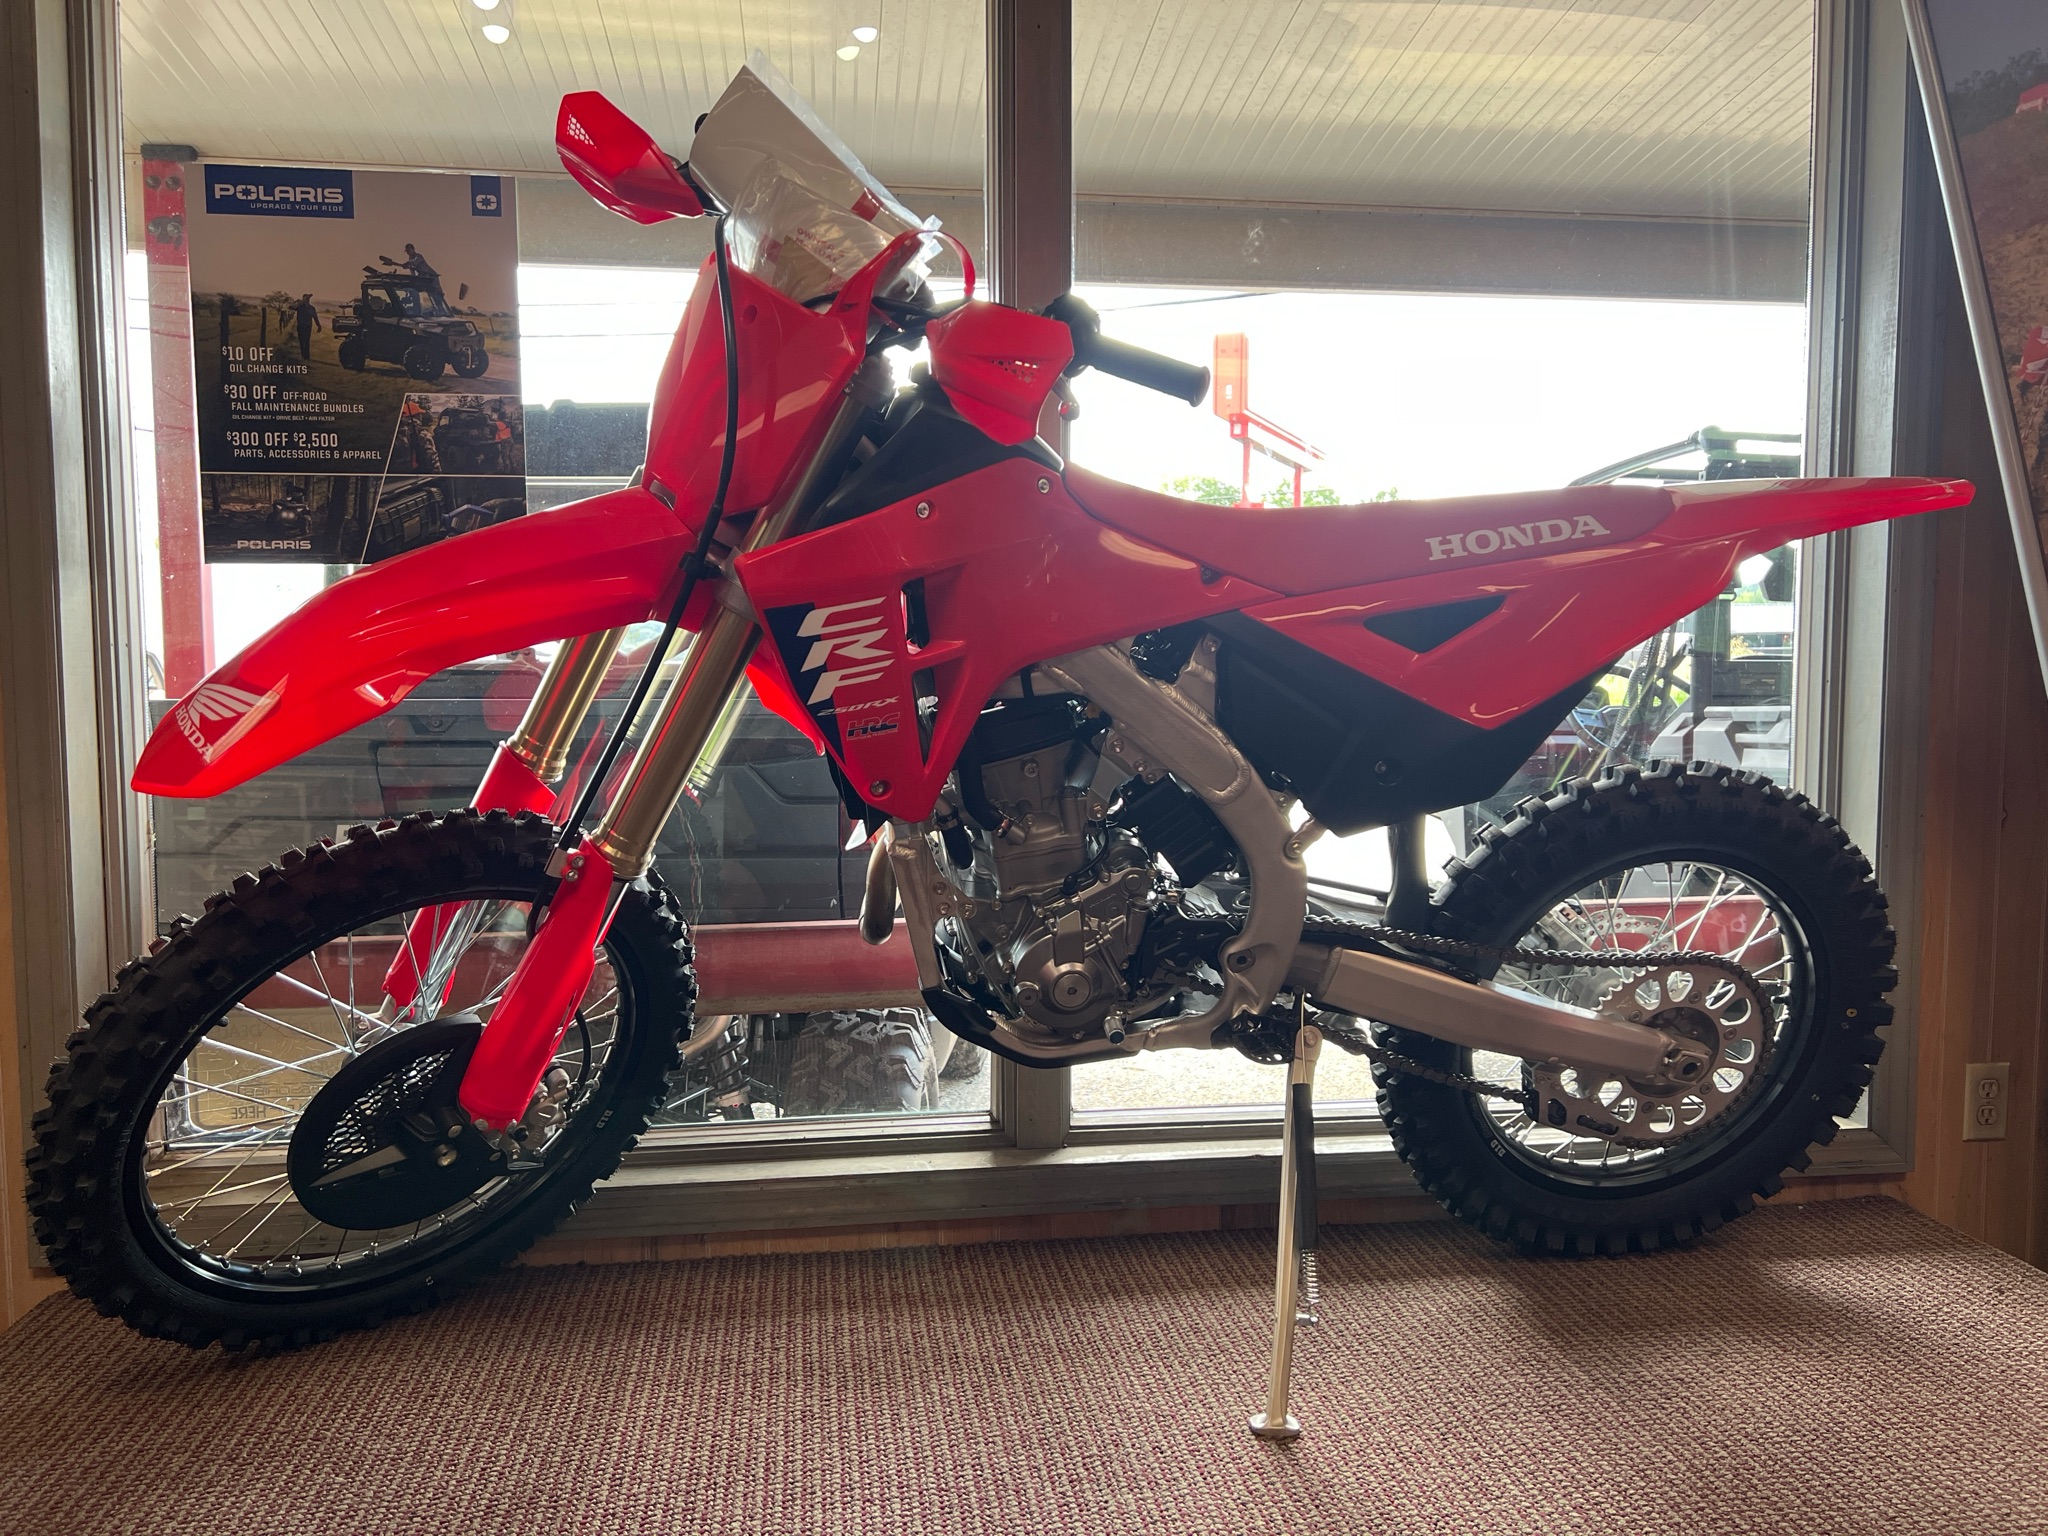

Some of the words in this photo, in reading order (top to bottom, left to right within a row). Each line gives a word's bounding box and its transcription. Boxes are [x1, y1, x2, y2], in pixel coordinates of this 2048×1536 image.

[214, 183, 344, 204] POLARIS
[250, 202, 292, 210] UPGRADE
[222, 345, 244, 361] $10
[249, 346, 274, 361] OFF
[229, 363, 245, 373] OIL
[247, 364, 284, 374] CHANGE
[286, 365, 308, 374] KITS
[224, 384, 247, 400] $30
[252, 385, 277, 400] OFF
[282, 391, 327, 401] OFF-ROAD
[231, 402, 253, 411] FALL
[255, 402, 320, 413] MAINTENANCE
[323, 404, 364, 413] BUNDLES
[226, 431, 259, 447] $300
[264, 432, 289, 447] OFF
[293, 432, 339, 449] $2,500
[234, 449, 266, 459] PARTS,
[268, 449, 331, 459] ACCESSORIES
[334, 450, 340, 459] &
[342, 450, 382, 460] APPAREL
[237, 540, 312, 550] POLARIS
[1424, 514, 1611, 561] HONDA
[796, 596, 896, 706] CRF
[817, 695, 900, 717] 250RX
[847, 711, 901, 739] HRC
[174, 704, 215, 764] HONDA
